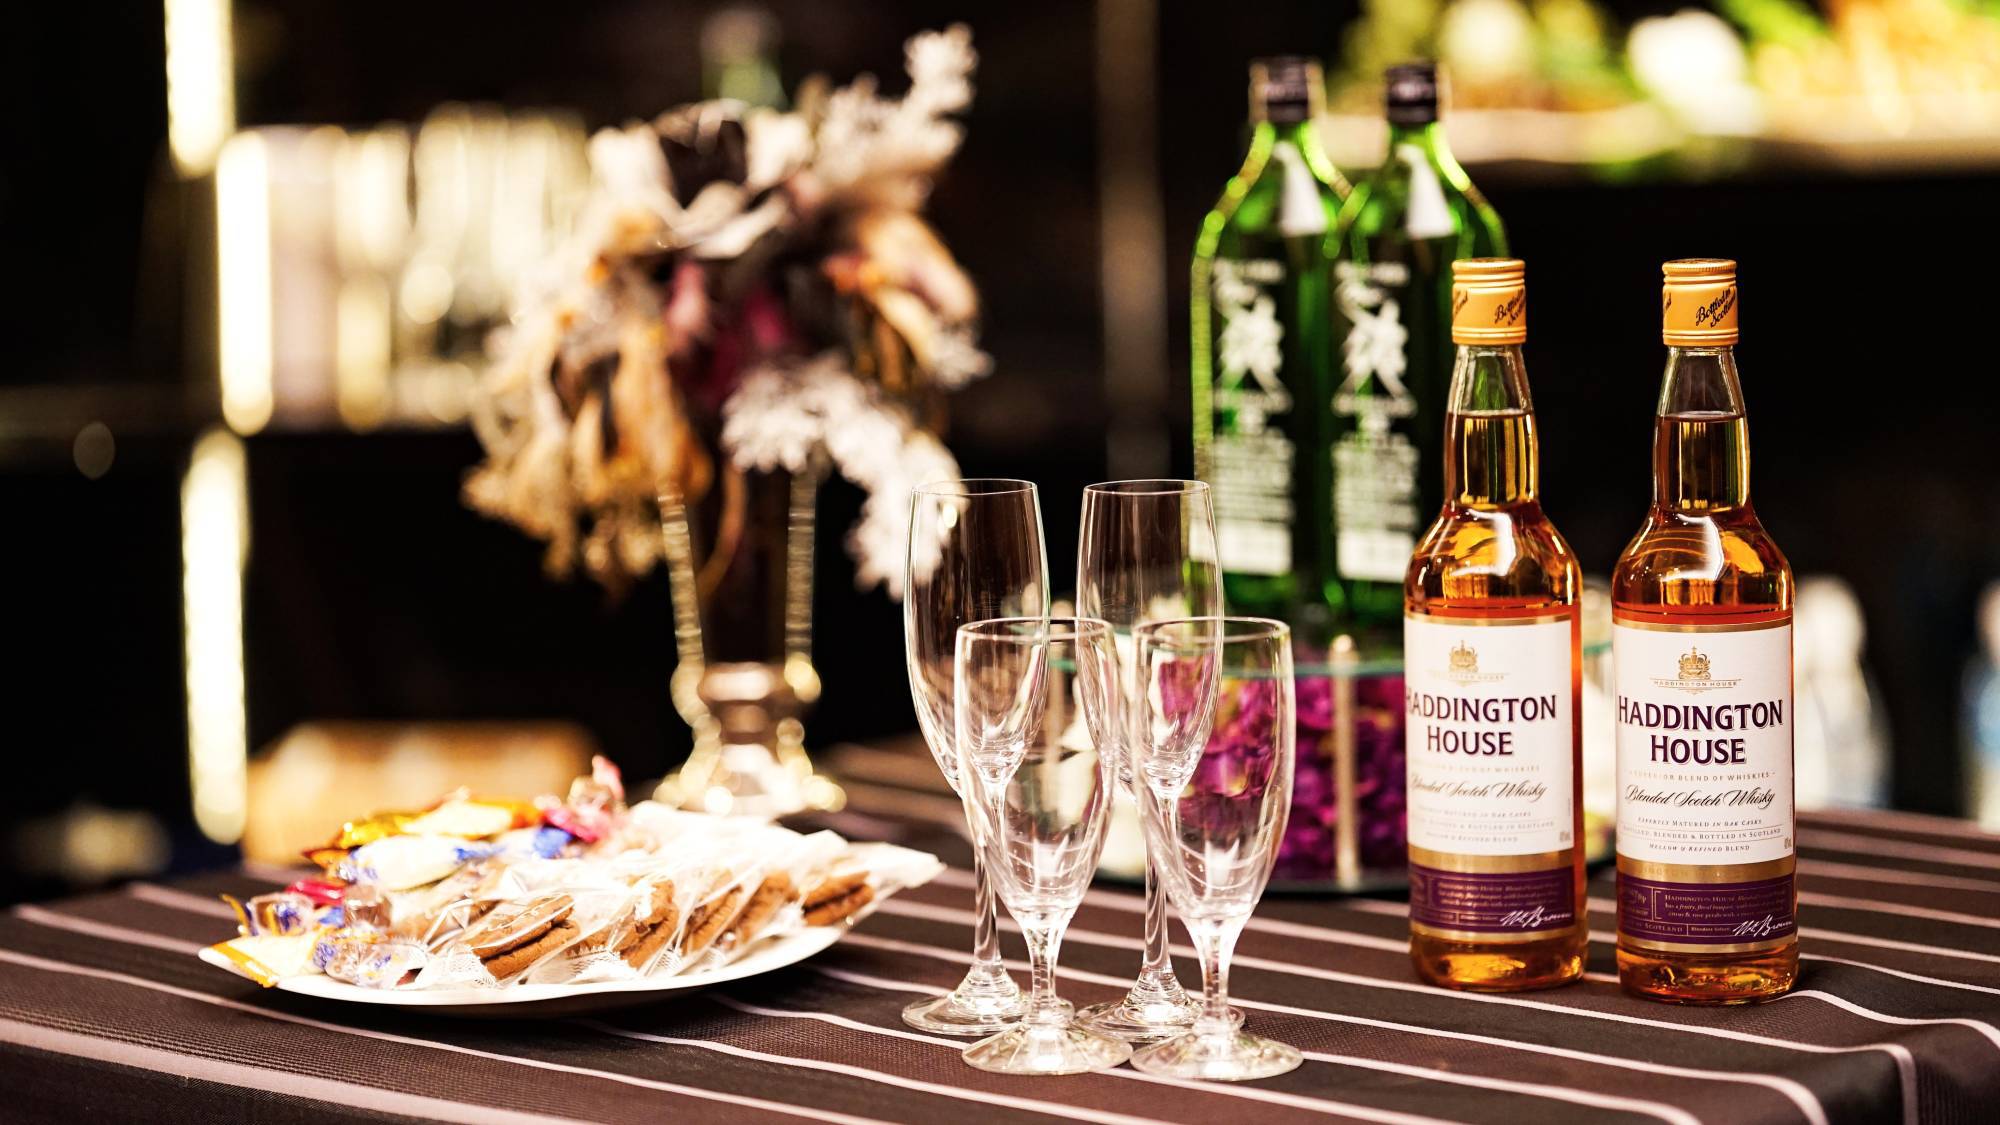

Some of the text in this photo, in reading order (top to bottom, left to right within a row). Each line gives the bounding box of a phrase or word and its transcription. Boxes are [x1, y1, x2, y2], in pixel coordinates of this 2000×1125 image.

[1618, 695, 1784, 731] HADDINGTON
[1427, 725, 1513, 756] HOUSE
[1650, 734, 1747, 765] HOUSE
[1678, 774, 1709, 782] BLEND
[1727, 771, 1770, 781] WHISKIES
[1446, 780, 1491, 798] Scotch
[1490, 779, 1548, 804] Whisky
[1625, 784, 1776, 810] Blended Scotch Whisky
[1653, 831, 1688, 839] BLENDED
[1748, 827, 1782, 838] SCOTLAND
[1672, 820, 1710, 828] MATURED
[1725, 844, 1751, 852] BLEND
